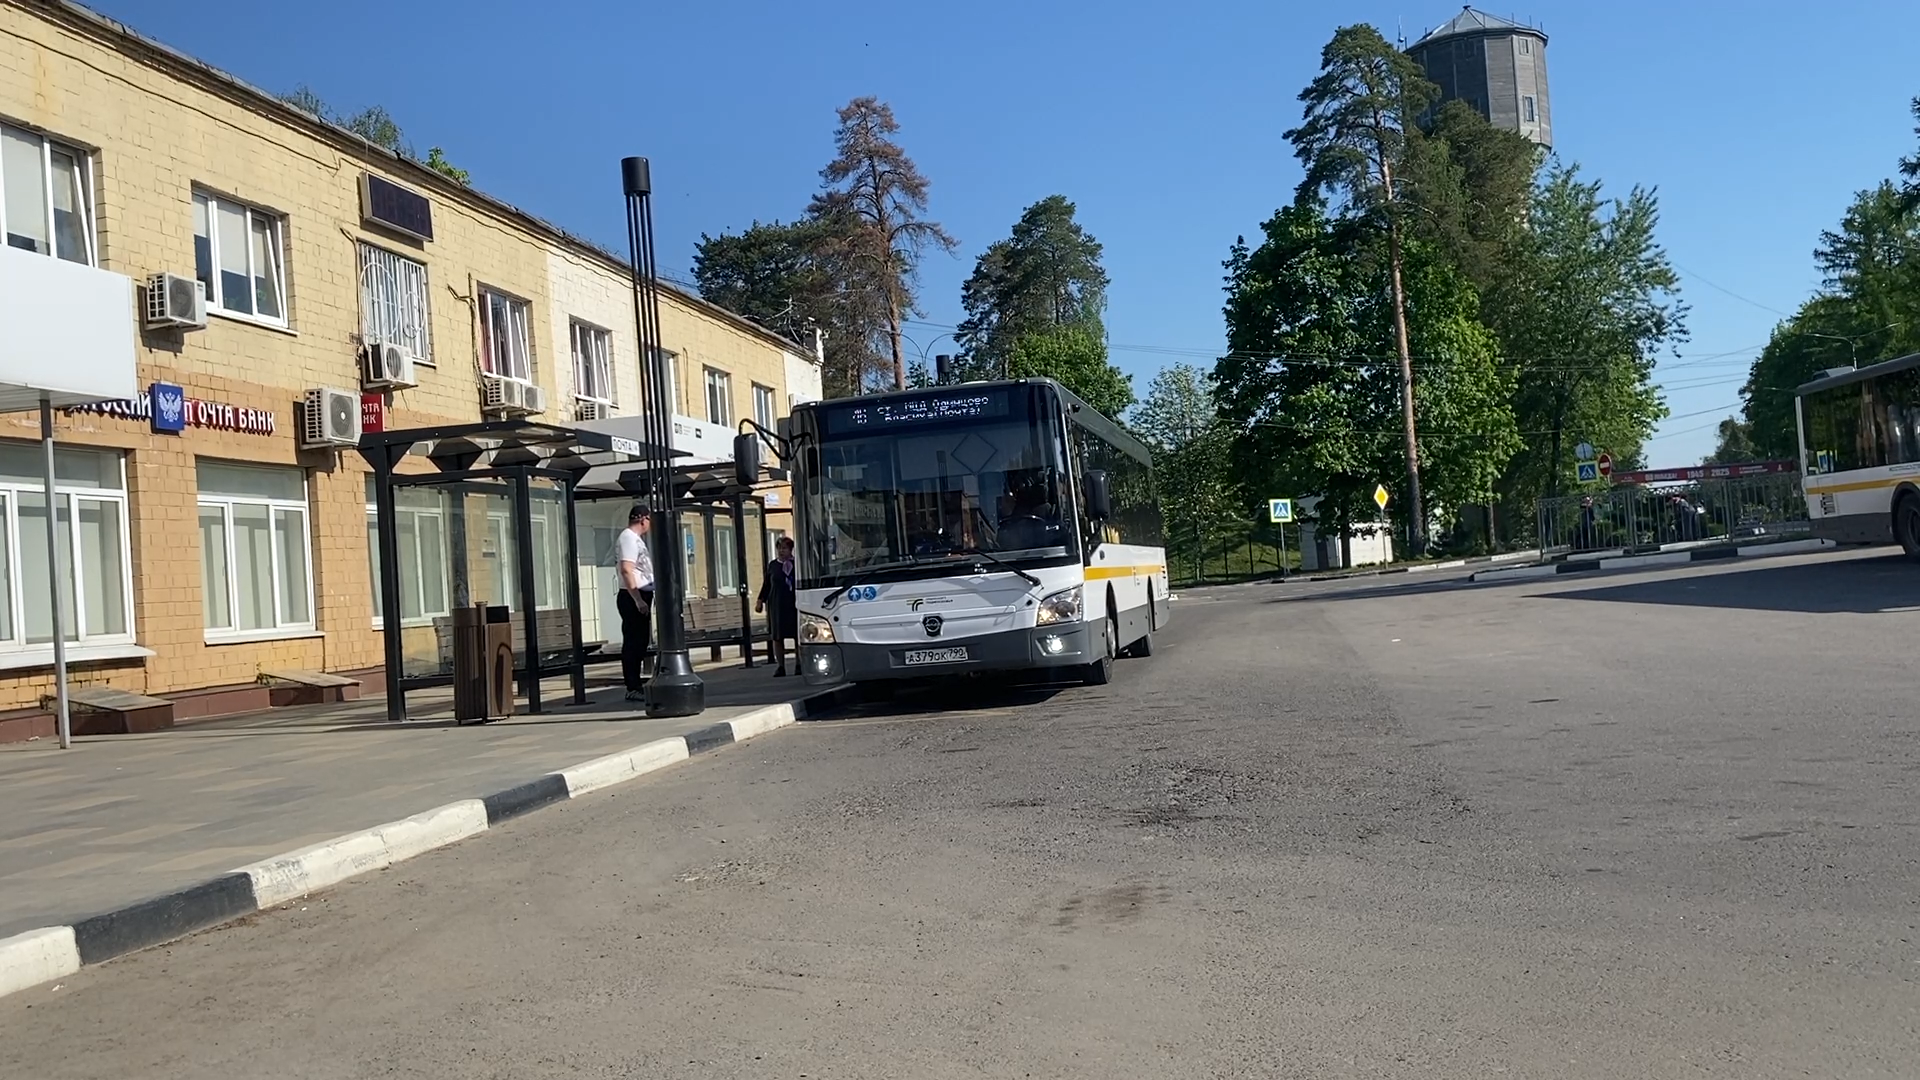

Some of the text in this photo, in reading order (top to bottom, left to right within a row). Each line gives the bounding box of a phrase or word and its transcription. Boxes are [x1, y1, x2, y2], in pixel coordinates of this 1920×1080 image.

[183, 401, 276, 432] ПОЧТА БАНК
[362, 402, 380, 413] ЧТА
